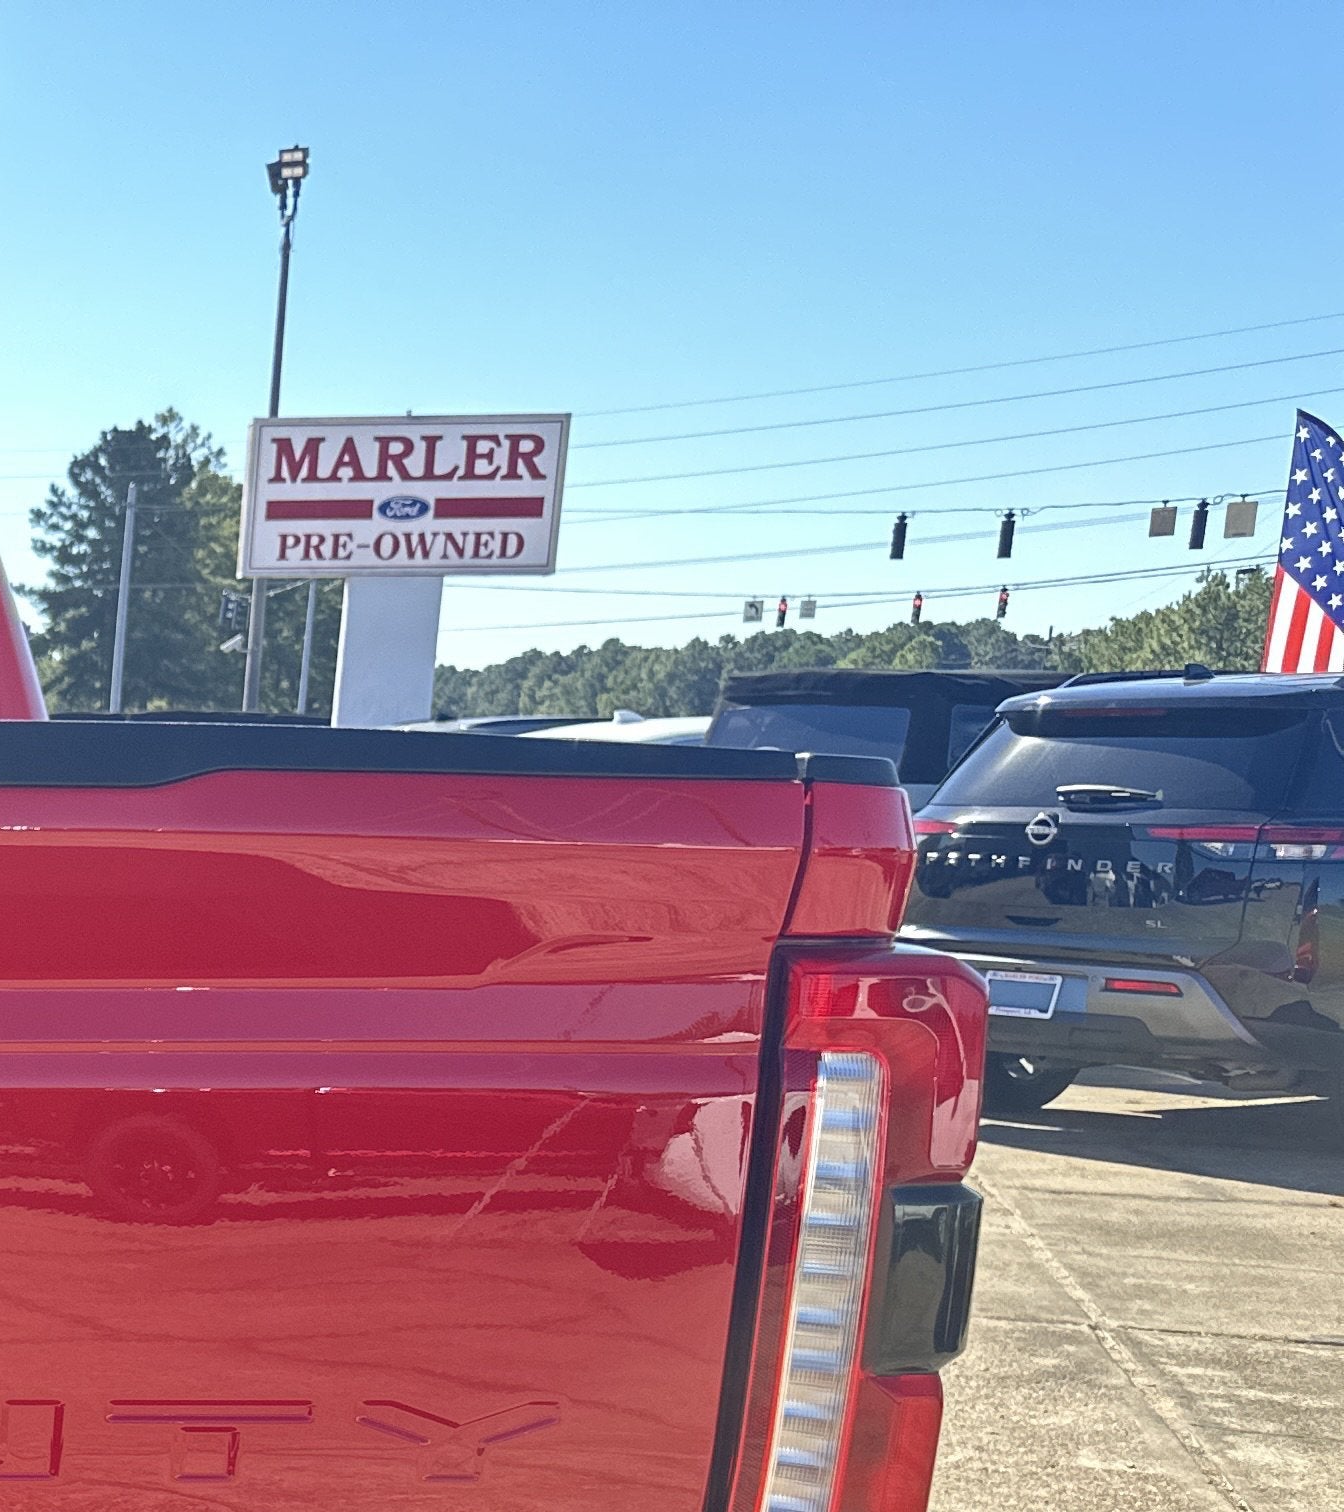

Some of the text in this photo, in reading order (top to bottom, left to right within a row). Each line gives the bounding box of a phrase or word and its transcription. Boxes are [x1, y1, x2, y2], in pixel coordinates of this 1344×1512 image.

[267, 433, 547, 484] MARLER
[275, 530, 526, 562] PRE-OWNED
[925, 851, 1175, 875] PATHFINDER
[1145, 919, 1168, 929] SL
